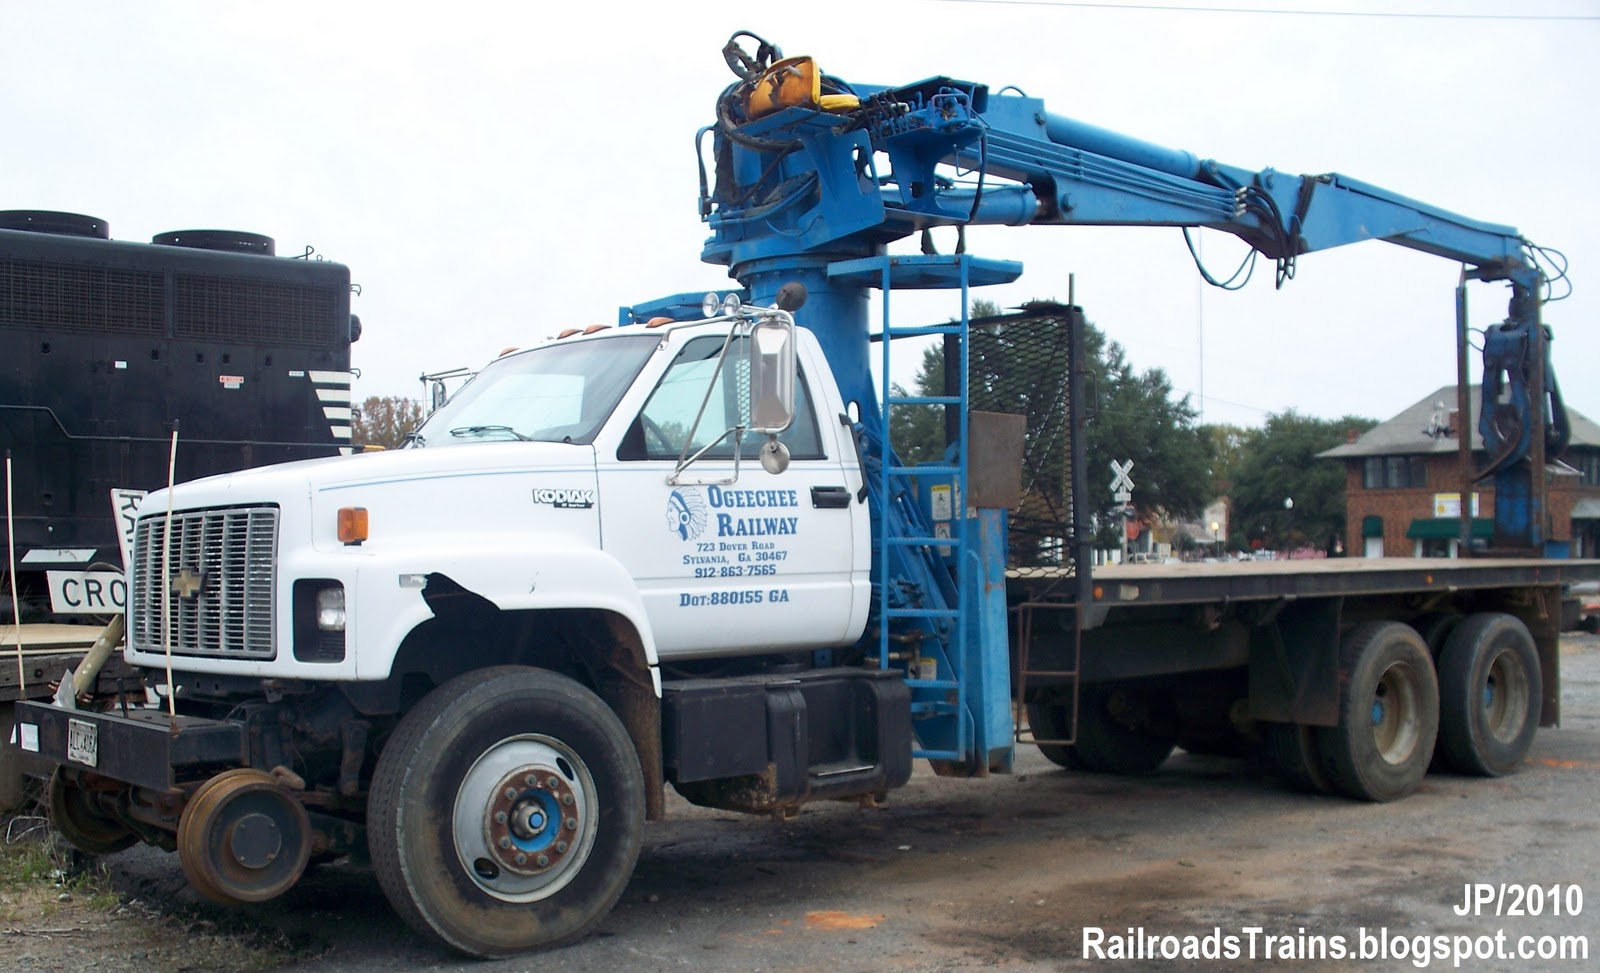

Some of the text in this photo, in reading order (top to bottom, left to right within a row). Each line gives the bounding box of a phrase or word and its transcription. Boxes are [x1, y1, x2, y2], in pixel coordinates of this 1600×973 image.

[532, 489, 594, 504] KODIAK
[707, 484, 799, 508] OGEECHEE
[716, 513, 799, 537] RAILWAY
[697, 541, 775, 552] 723 DOVER ROAD
[683, 551, 788, 565] SYLVANIA, GA 30467
[694, 564, 776, 578] 912-863-7565
[679, 589, 790, 607] DOT:880155 GA
